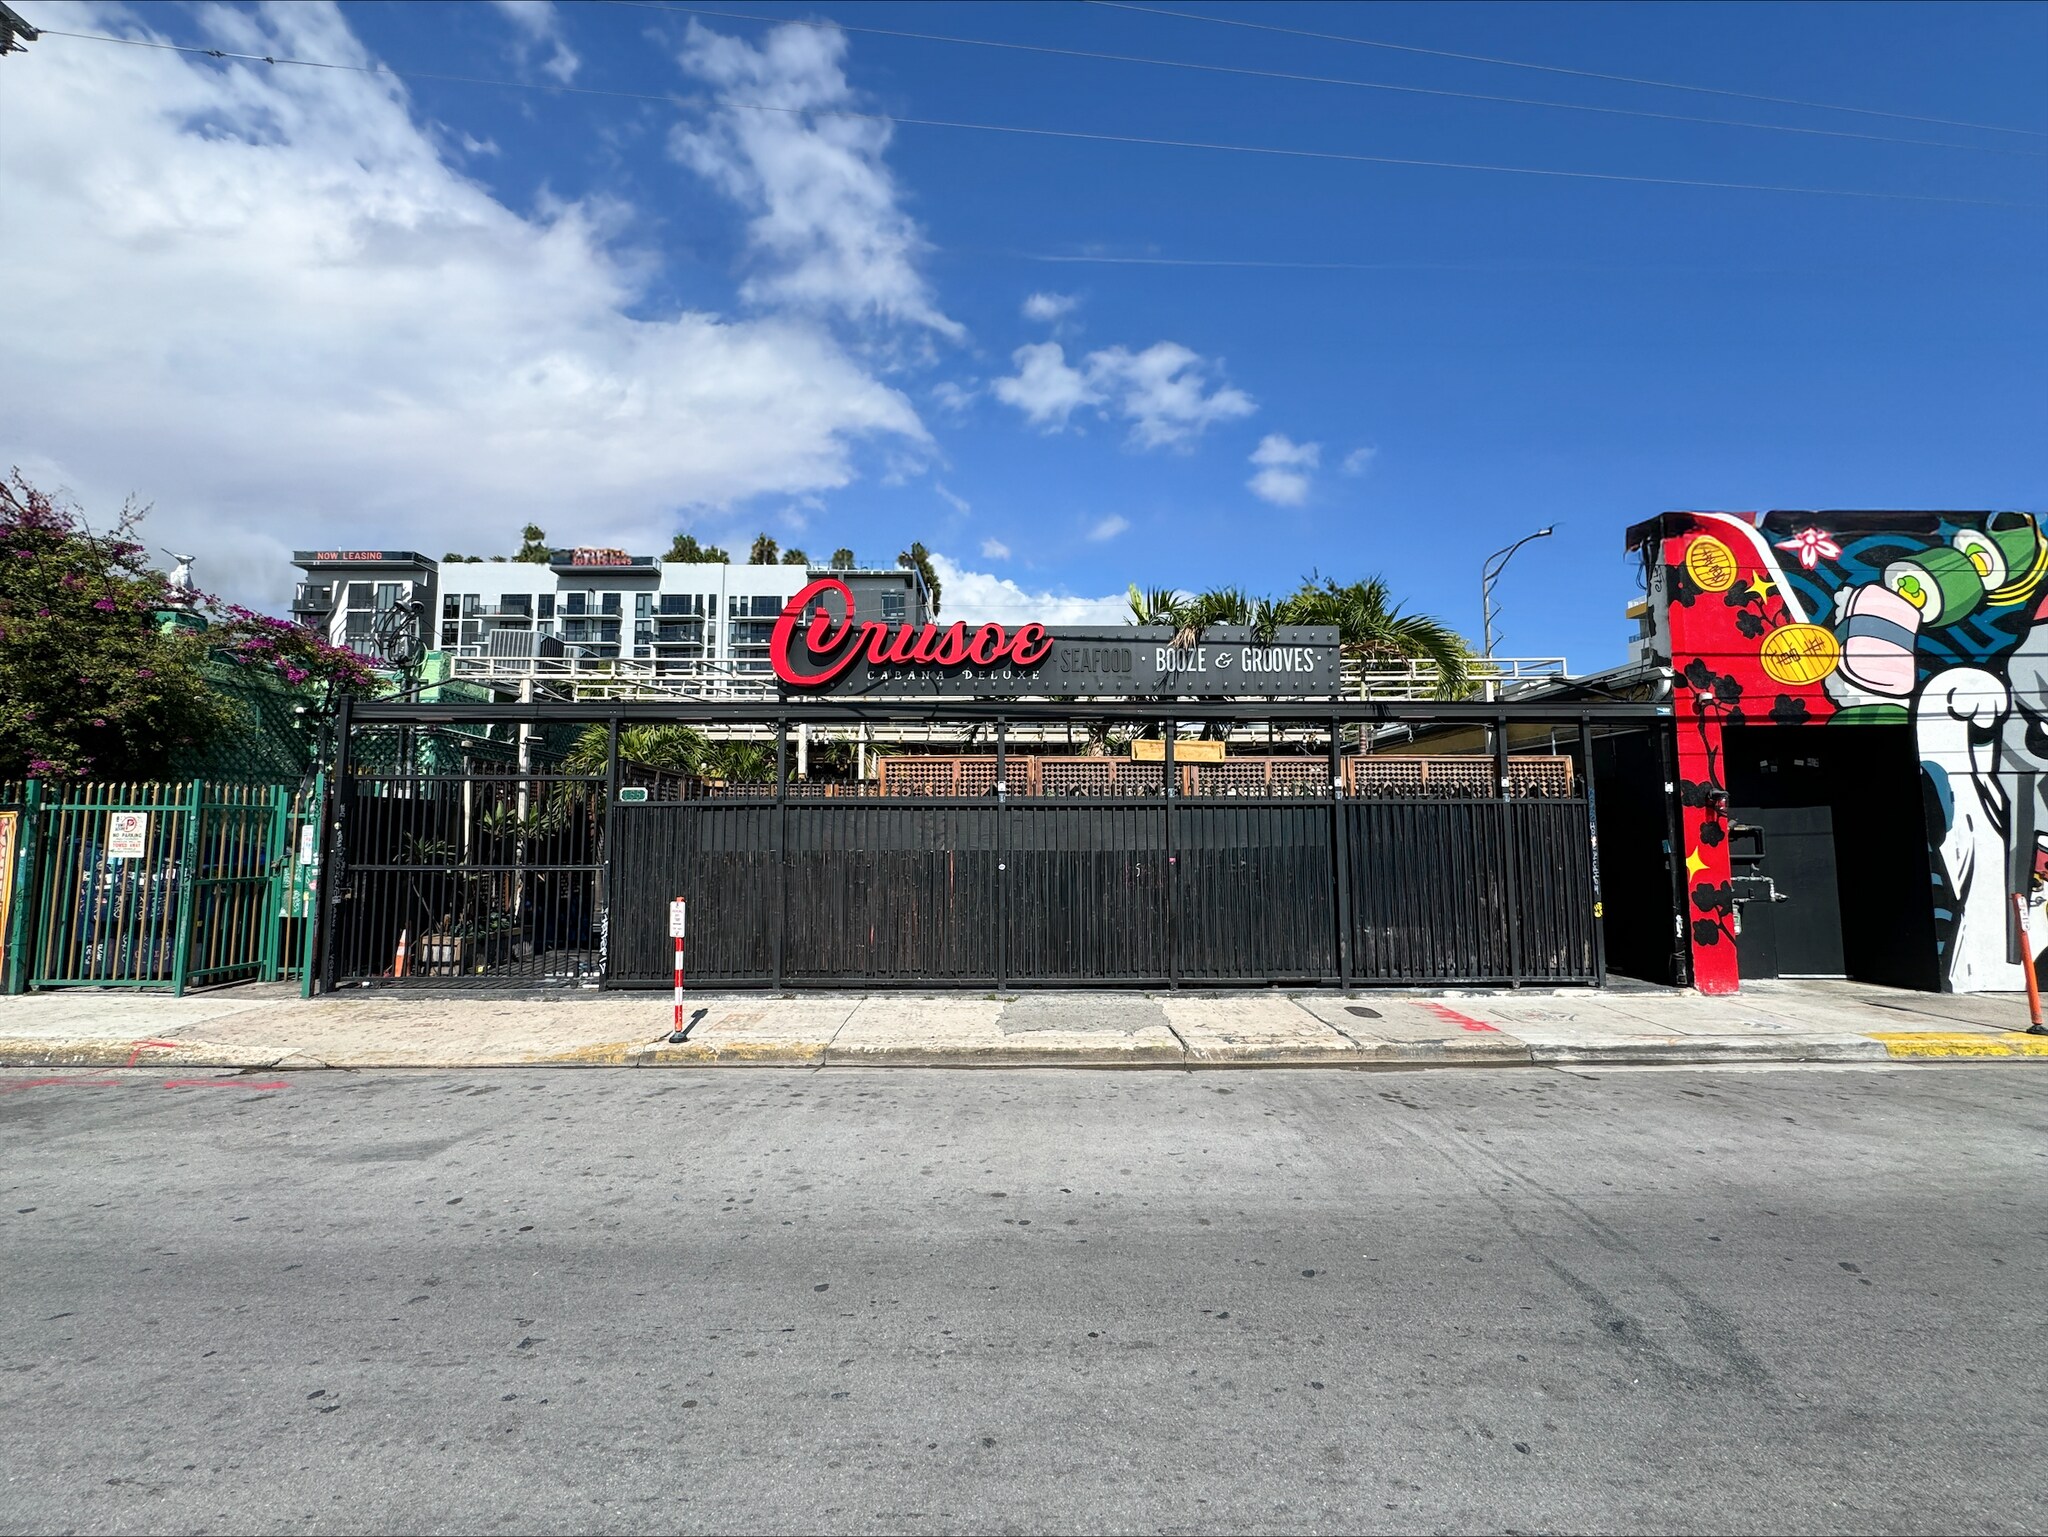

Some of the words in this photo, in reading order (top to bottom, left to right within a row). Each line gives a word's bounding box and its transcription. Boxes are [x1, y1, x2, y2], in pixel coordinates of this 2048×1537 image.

[317, 552, 338, 560] NOW
[342, 552, 382, 560] LEASING
[770, 578, 1054, 686] Crusoe
[1060, 648, 1132, 673] SEAFOOD
[1156, 647, 1206, 672] BOOZE
[1215, 652, 1233, 669] &
[1241, 647, 1314, 673] GROOVES
[867, 670, 945, 680] CABANA
[961, 669, 1040, 680] DELUXE
